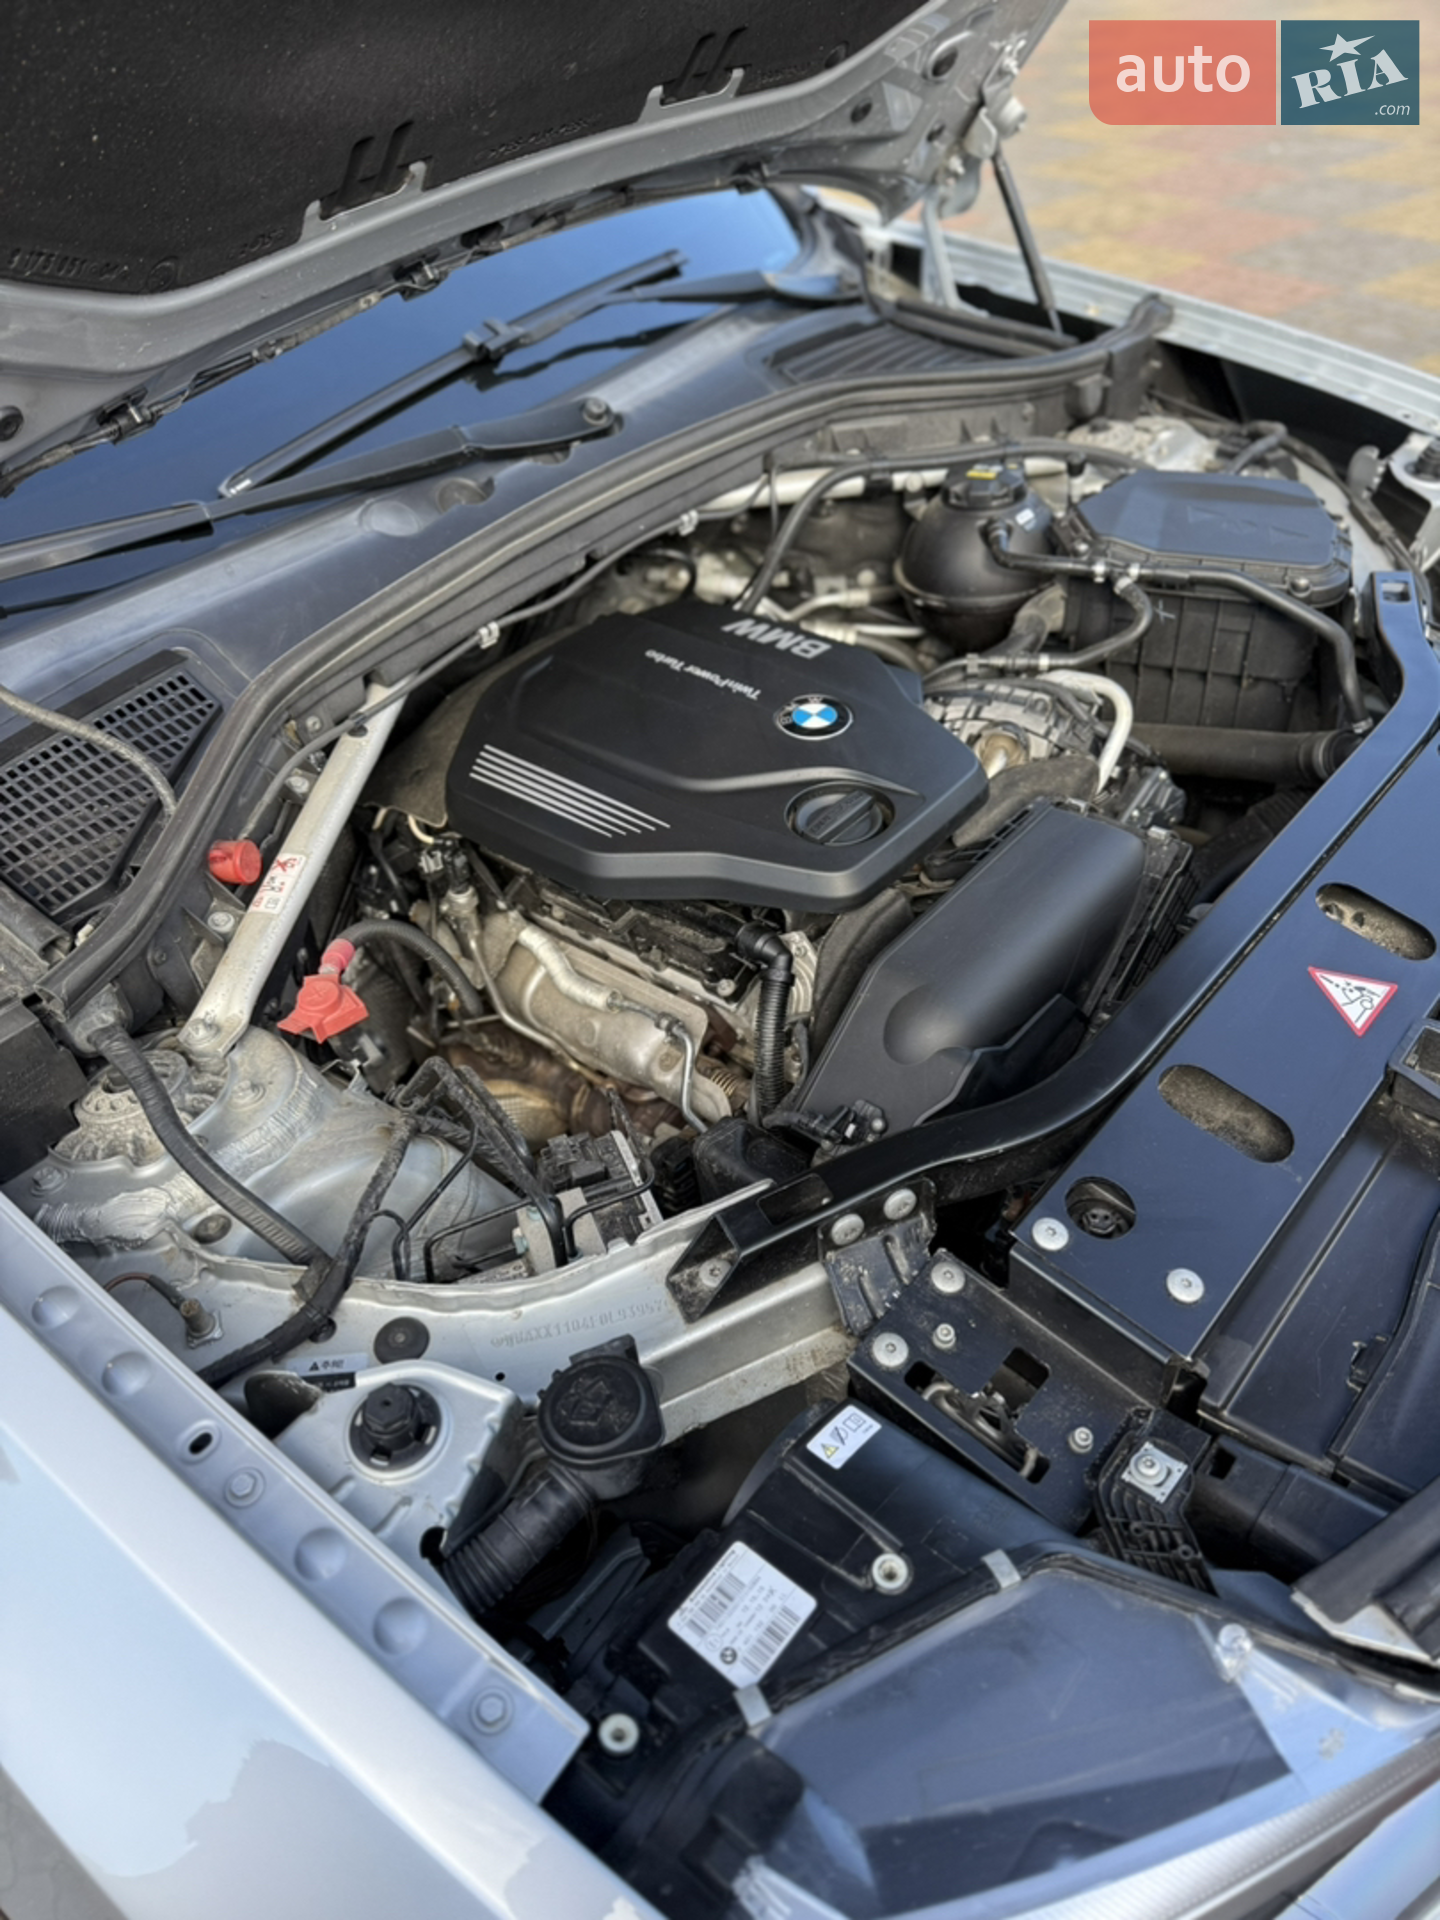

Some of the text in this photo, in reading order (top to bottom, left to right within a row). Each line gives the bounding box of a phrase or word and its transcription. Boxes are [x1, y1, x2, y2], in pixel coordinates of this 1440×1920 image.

[720, 617, 833, 659] BMW
[645, 649, 761, 700] TwinPower Turbo
